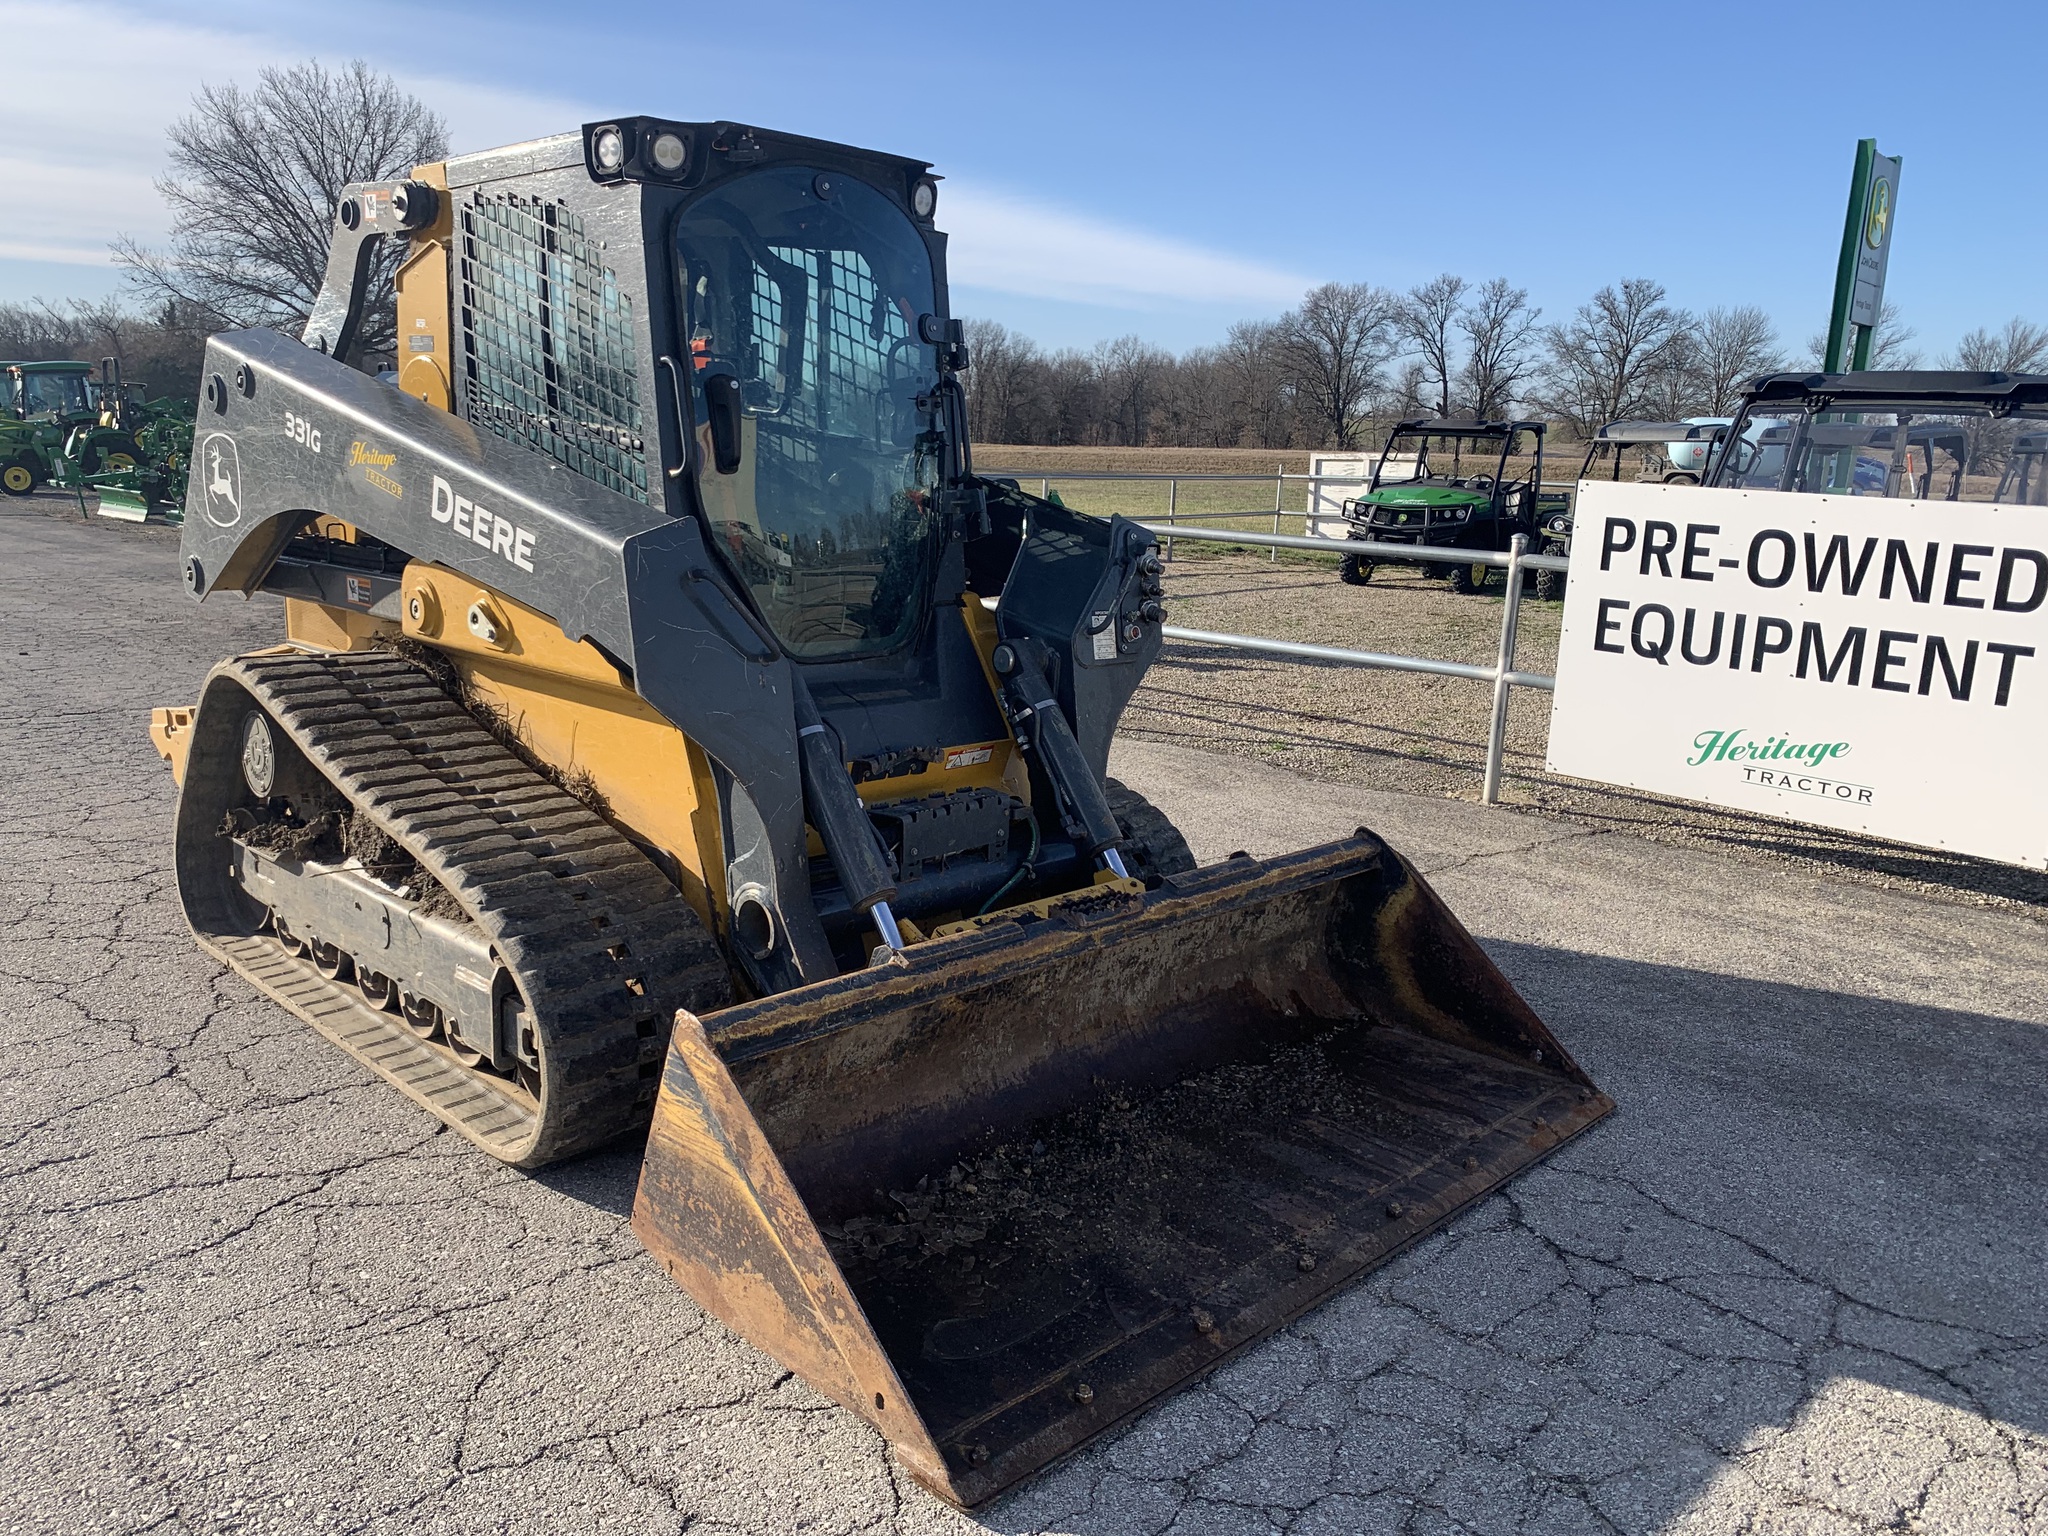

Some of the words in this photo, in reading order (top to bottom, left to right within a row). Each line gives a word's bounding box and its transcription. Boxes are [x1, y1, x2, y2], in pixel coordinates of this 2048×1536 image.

[284, 411, 322, 453] 331G
[349, 441, 397, 471] Heritage
[365, 469, 403, 497] TRACTOR
[430, 474, 537, 574] DEERE
[1599, 516, 2048, 614] PRE-OWNED
[1593, 598, 2036, 707] EQUIPMENT
[1686, 728, 1852, 768] Heritage
[1742, 767, 1873, 803] TRACTOR
